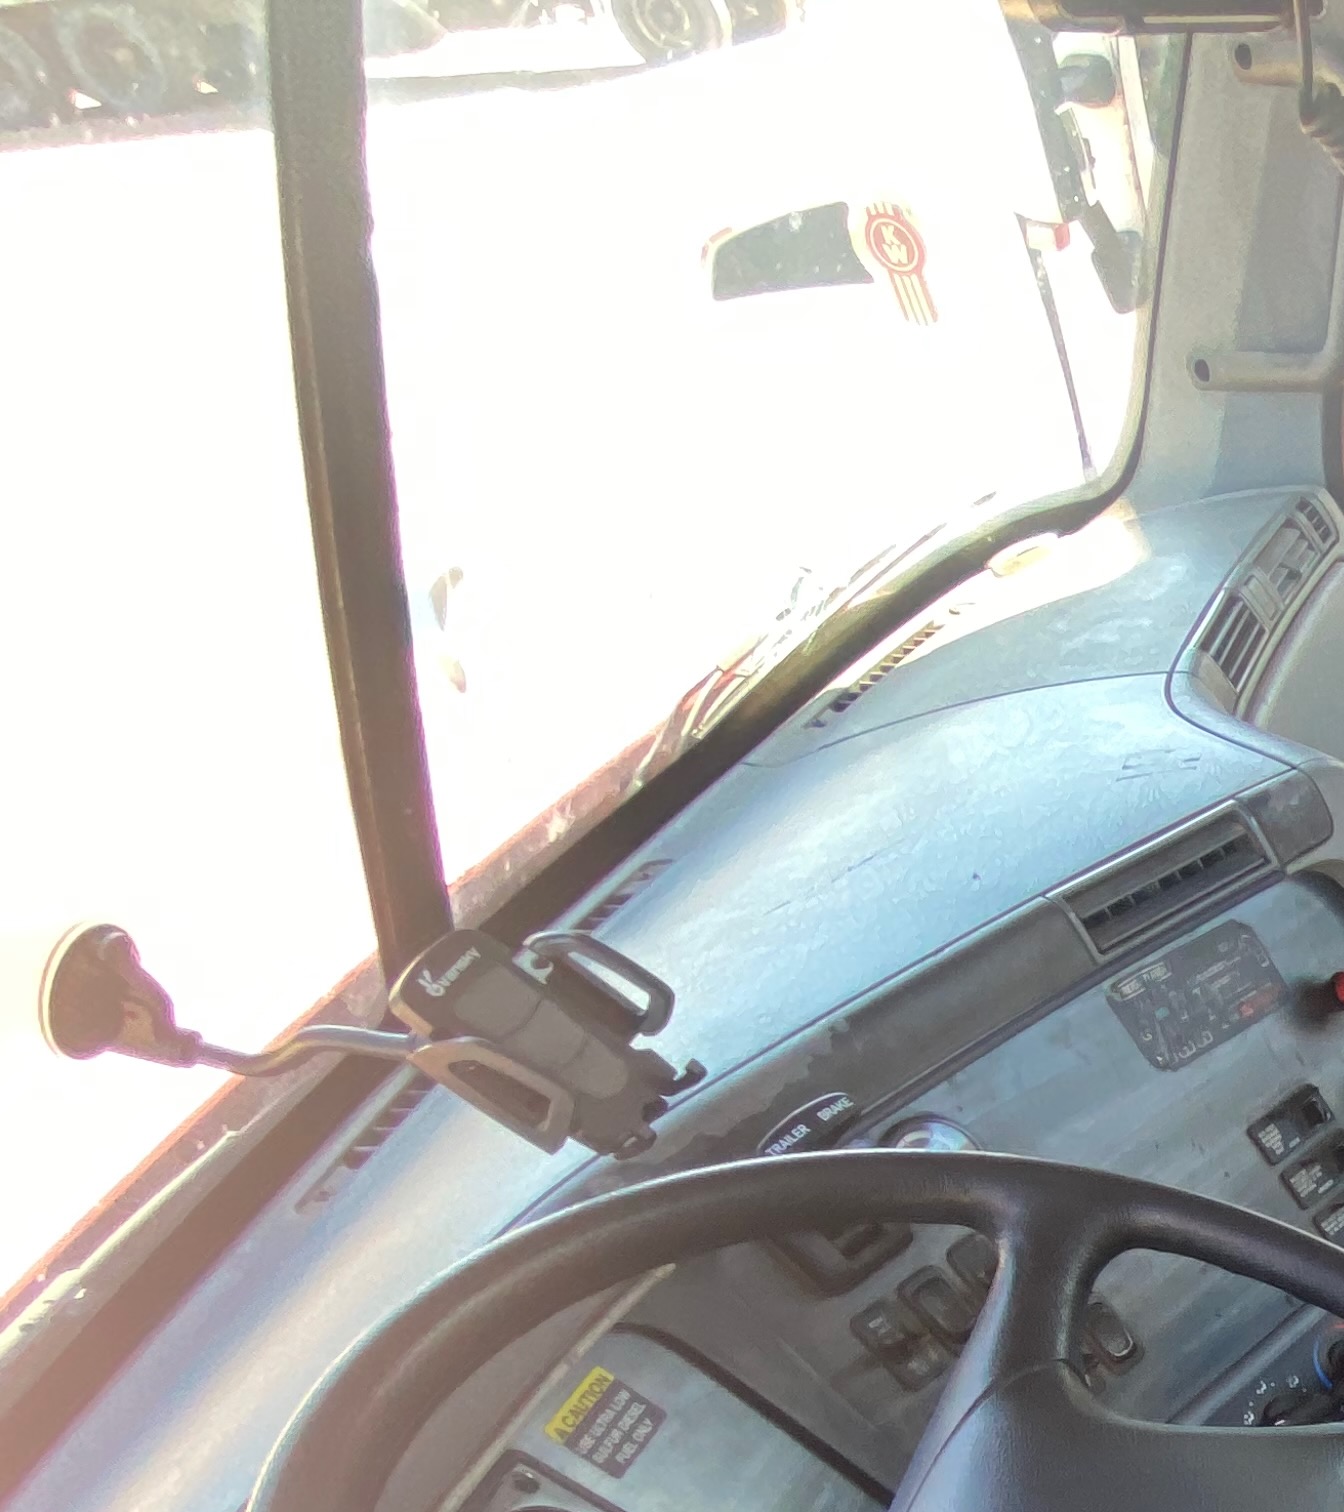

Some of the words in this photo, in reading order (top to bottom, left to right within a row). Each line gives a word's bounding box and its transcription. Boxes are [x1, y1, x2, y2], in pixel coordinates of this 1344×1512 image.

[765, 1124, 811, 1155] TRAILER
[817, 1096, 854, 1121] BRAKE
[561, 1373, 610, 1428] CAUTION
[615, 1441, 639, 1463] FUEL
